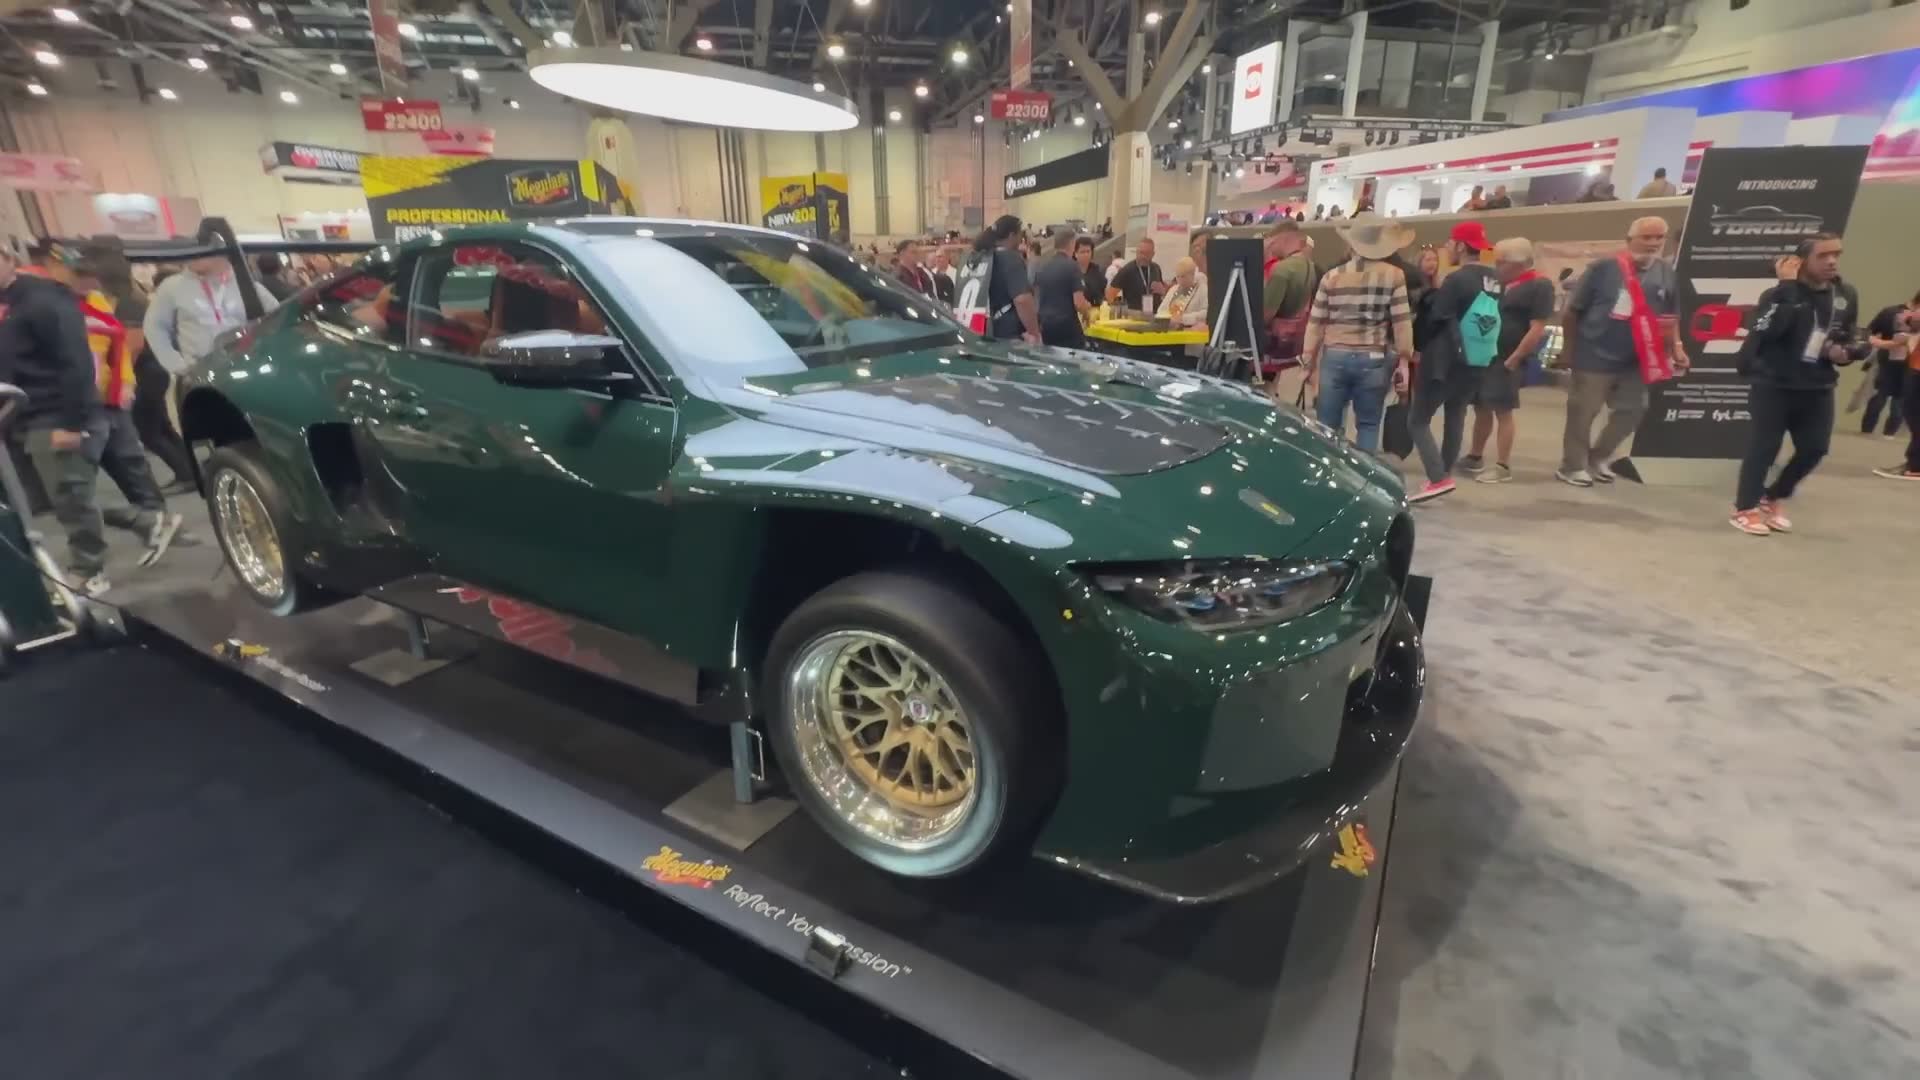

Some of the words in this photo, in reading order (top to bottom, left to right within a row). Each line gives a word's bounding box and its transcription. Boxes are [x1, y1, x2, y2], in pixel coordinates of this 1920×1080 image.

[1006, 104, 1049, 118] 22300
[384, 112, 441, 131] 22400
[1737, 179, 1818, 191] INTRODUCING
[386, 208, 511, 224] PROFESSIONAL
[723, 884, 786, 921] Reflect
